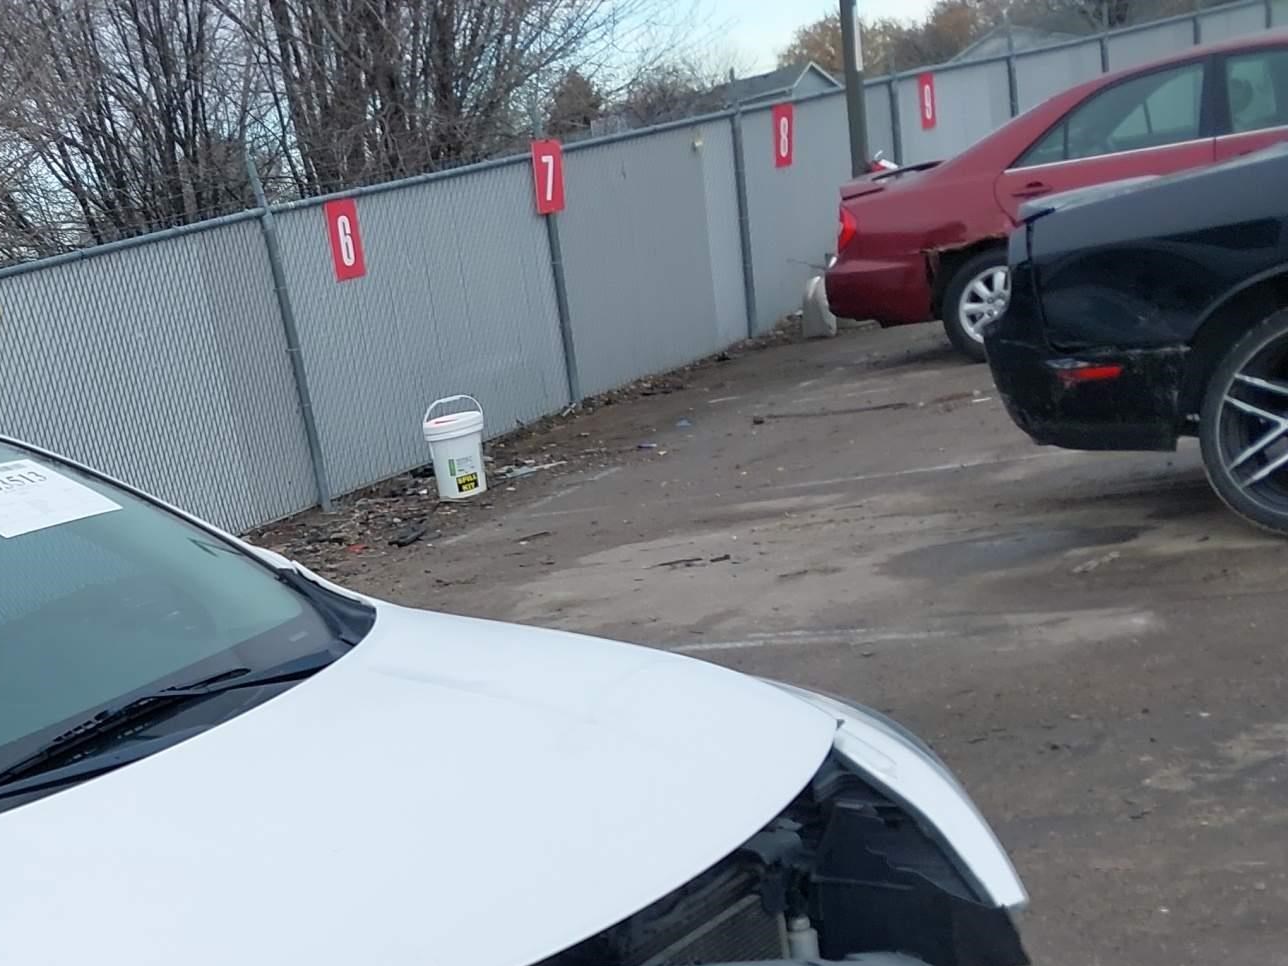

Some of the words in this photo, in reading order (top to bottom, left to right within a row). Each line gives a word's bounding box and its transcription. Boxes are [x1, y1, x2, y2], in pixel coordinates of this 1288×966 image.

[924, 84, 932, 120] 9
[780, 116, 789, 158] 8
[541, 155, 554, 201] 7
[337, 215, 356, 266] 6
